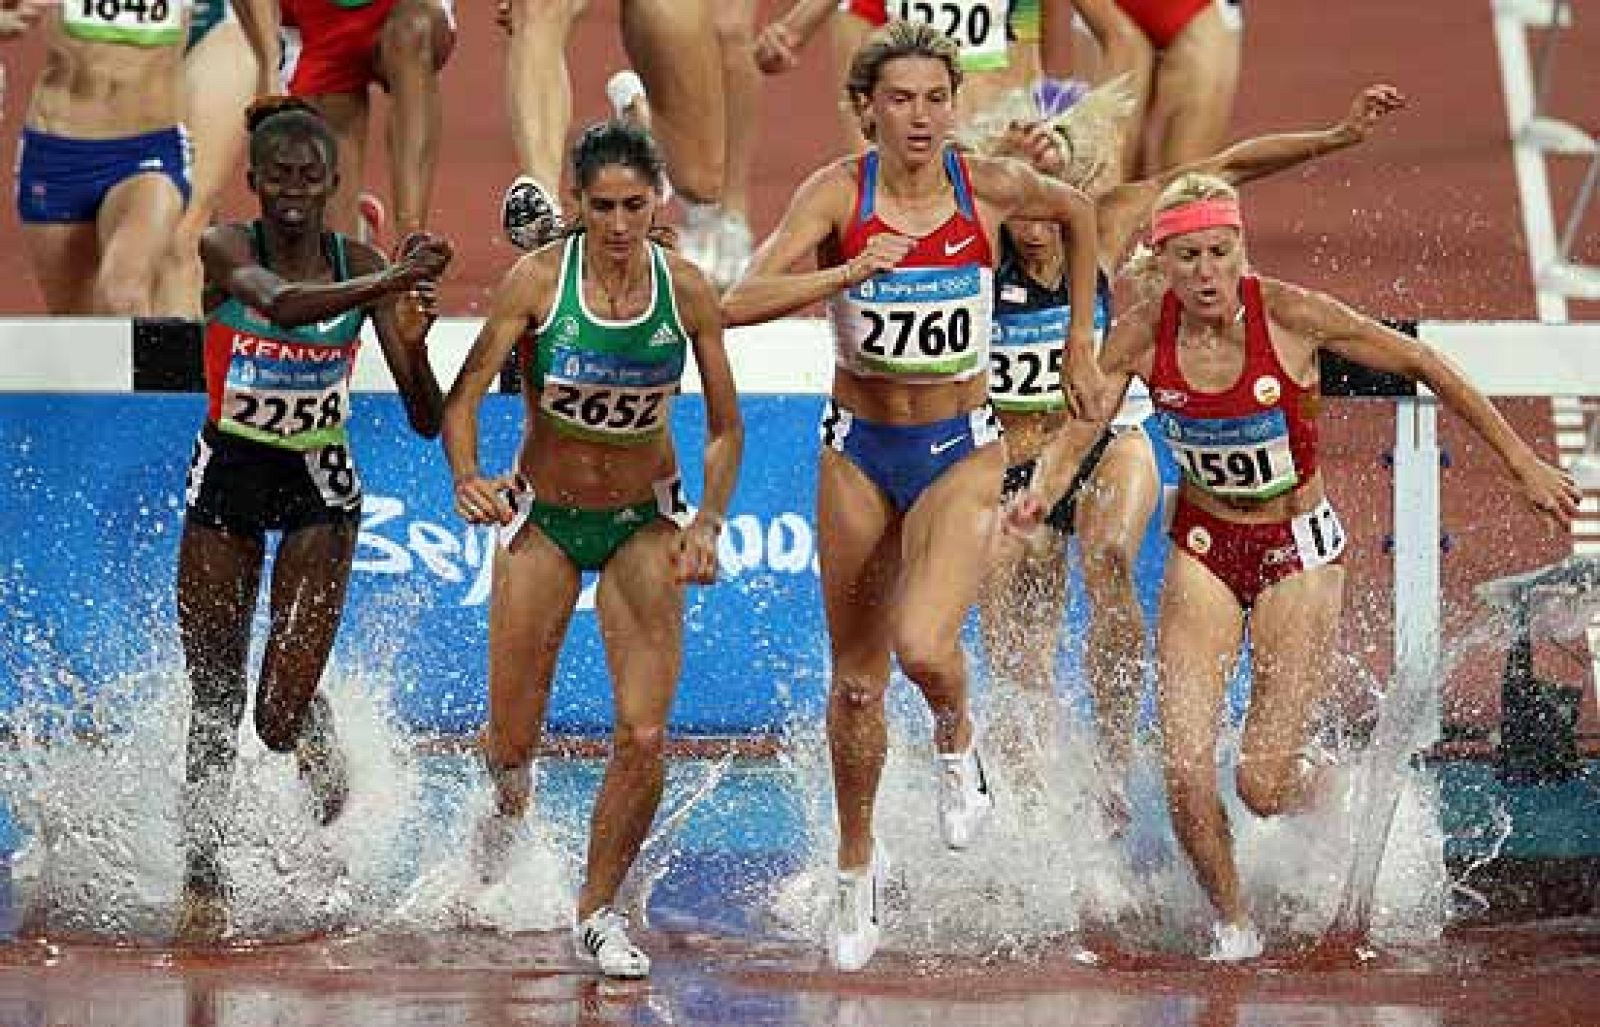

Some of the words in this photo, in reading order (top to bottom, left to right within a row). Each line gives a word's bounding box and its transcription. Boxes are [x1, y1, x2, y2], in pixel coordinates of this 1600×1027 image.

[861, 307, 970, 356] 2760
[232, 391, 341, 437] 2258
[550, 385, 664, 428] 2652
[1184, 448, 1273, 487] 1591
